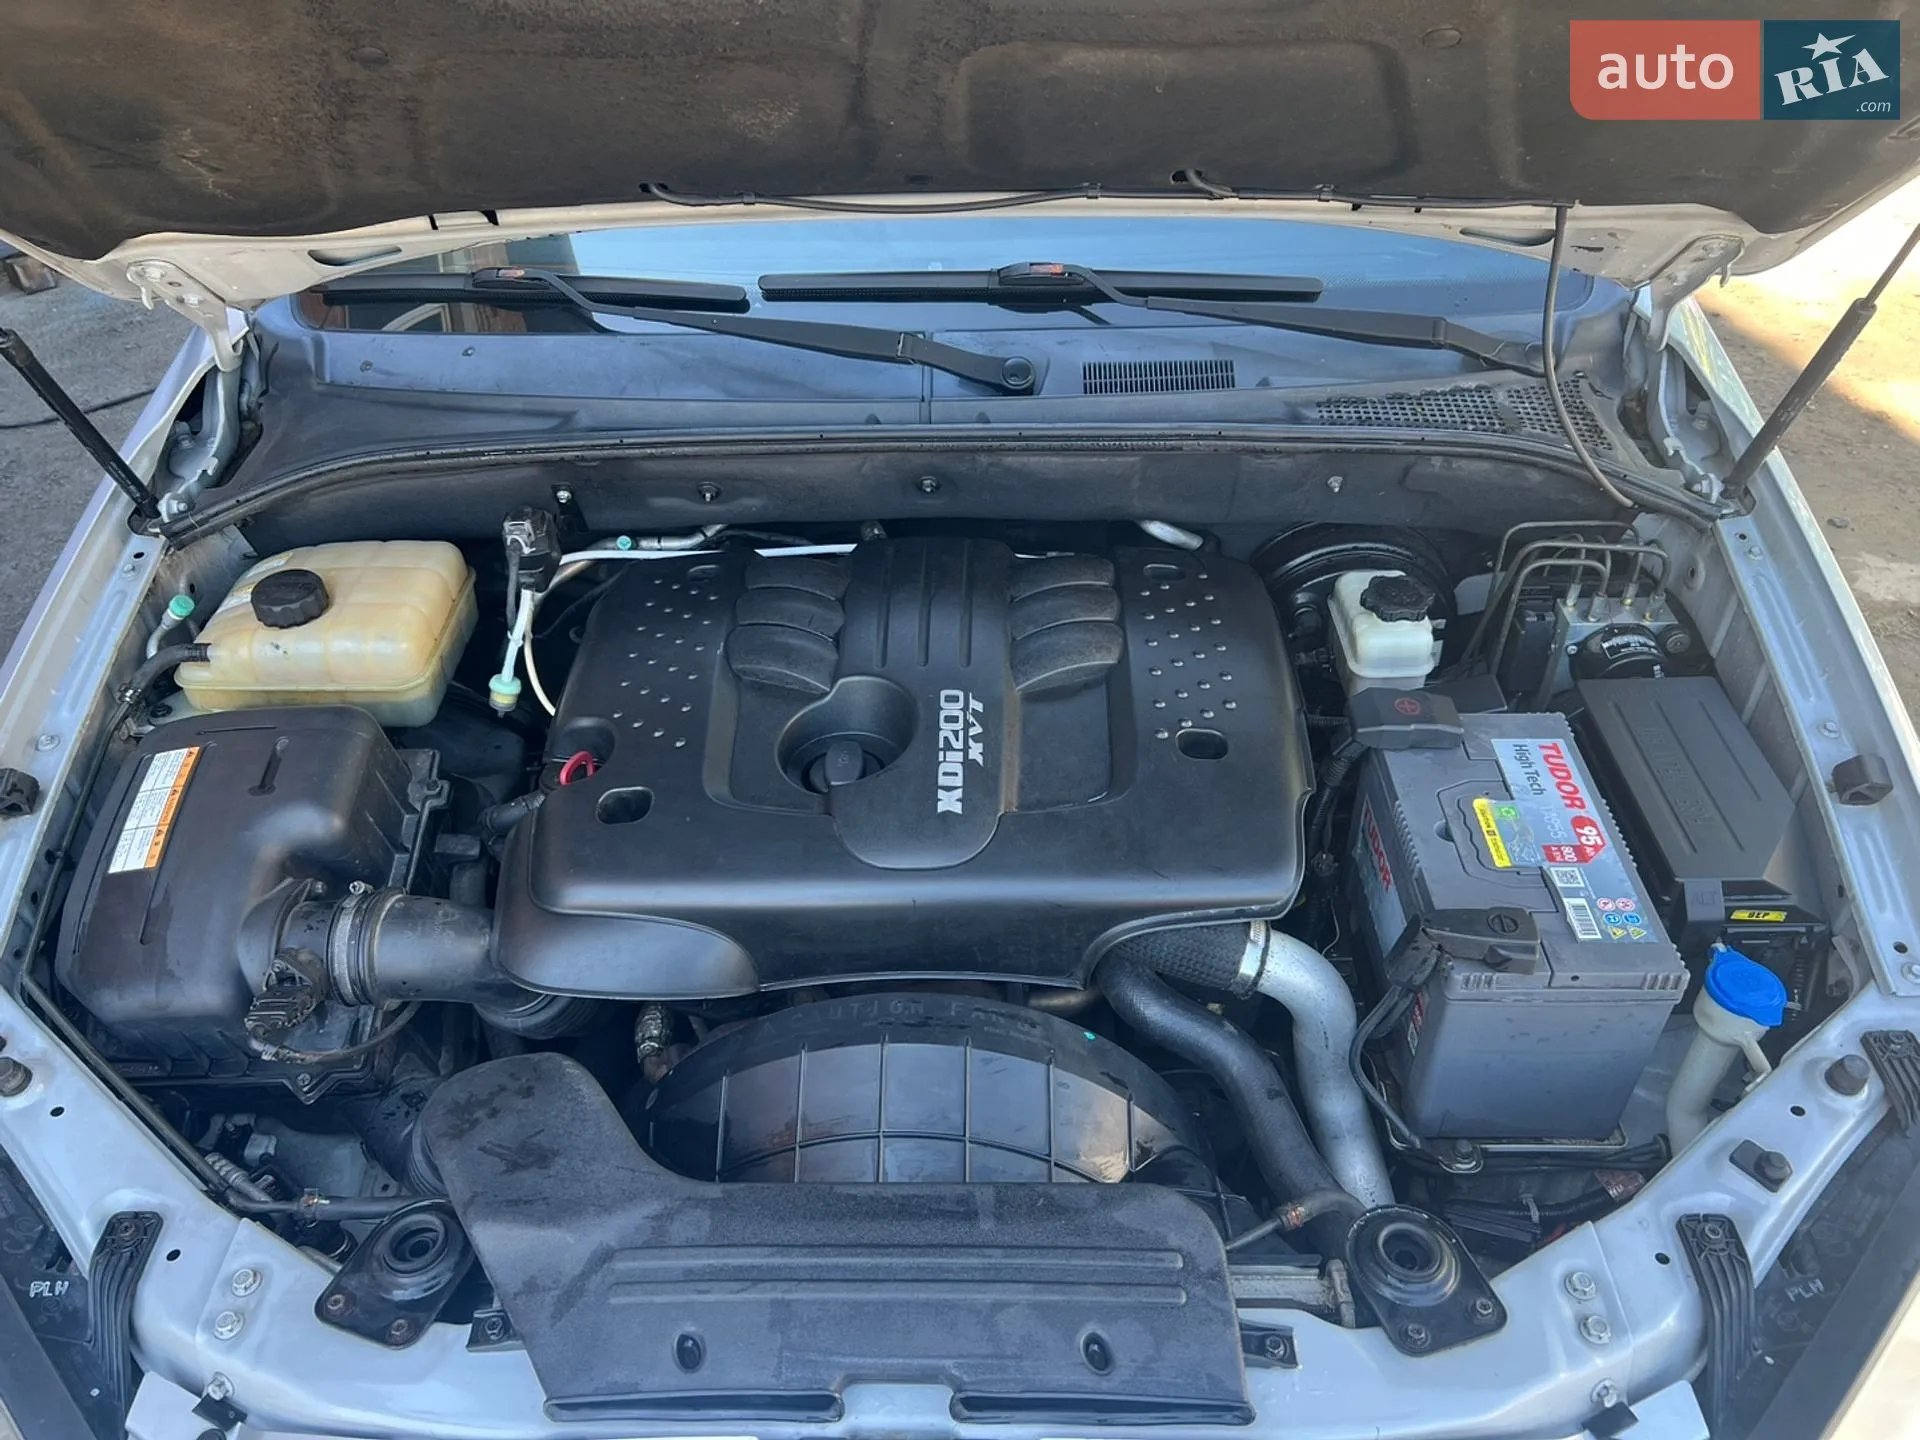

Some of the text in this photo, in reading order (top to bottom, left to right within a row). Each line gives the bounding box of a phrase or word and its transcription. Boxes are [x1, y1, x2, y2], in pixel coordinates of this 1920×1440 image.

[937, 689, 964, 815] XDi200
[1513, 744, 1547, 796] High Tech
[1538, 743, 1586, 810] TUDOR
[1365, 807, 1391, 893] TUDOR
[1561, 846, 1577, 862] 800
[1576, 825, 1603, 847] 95
